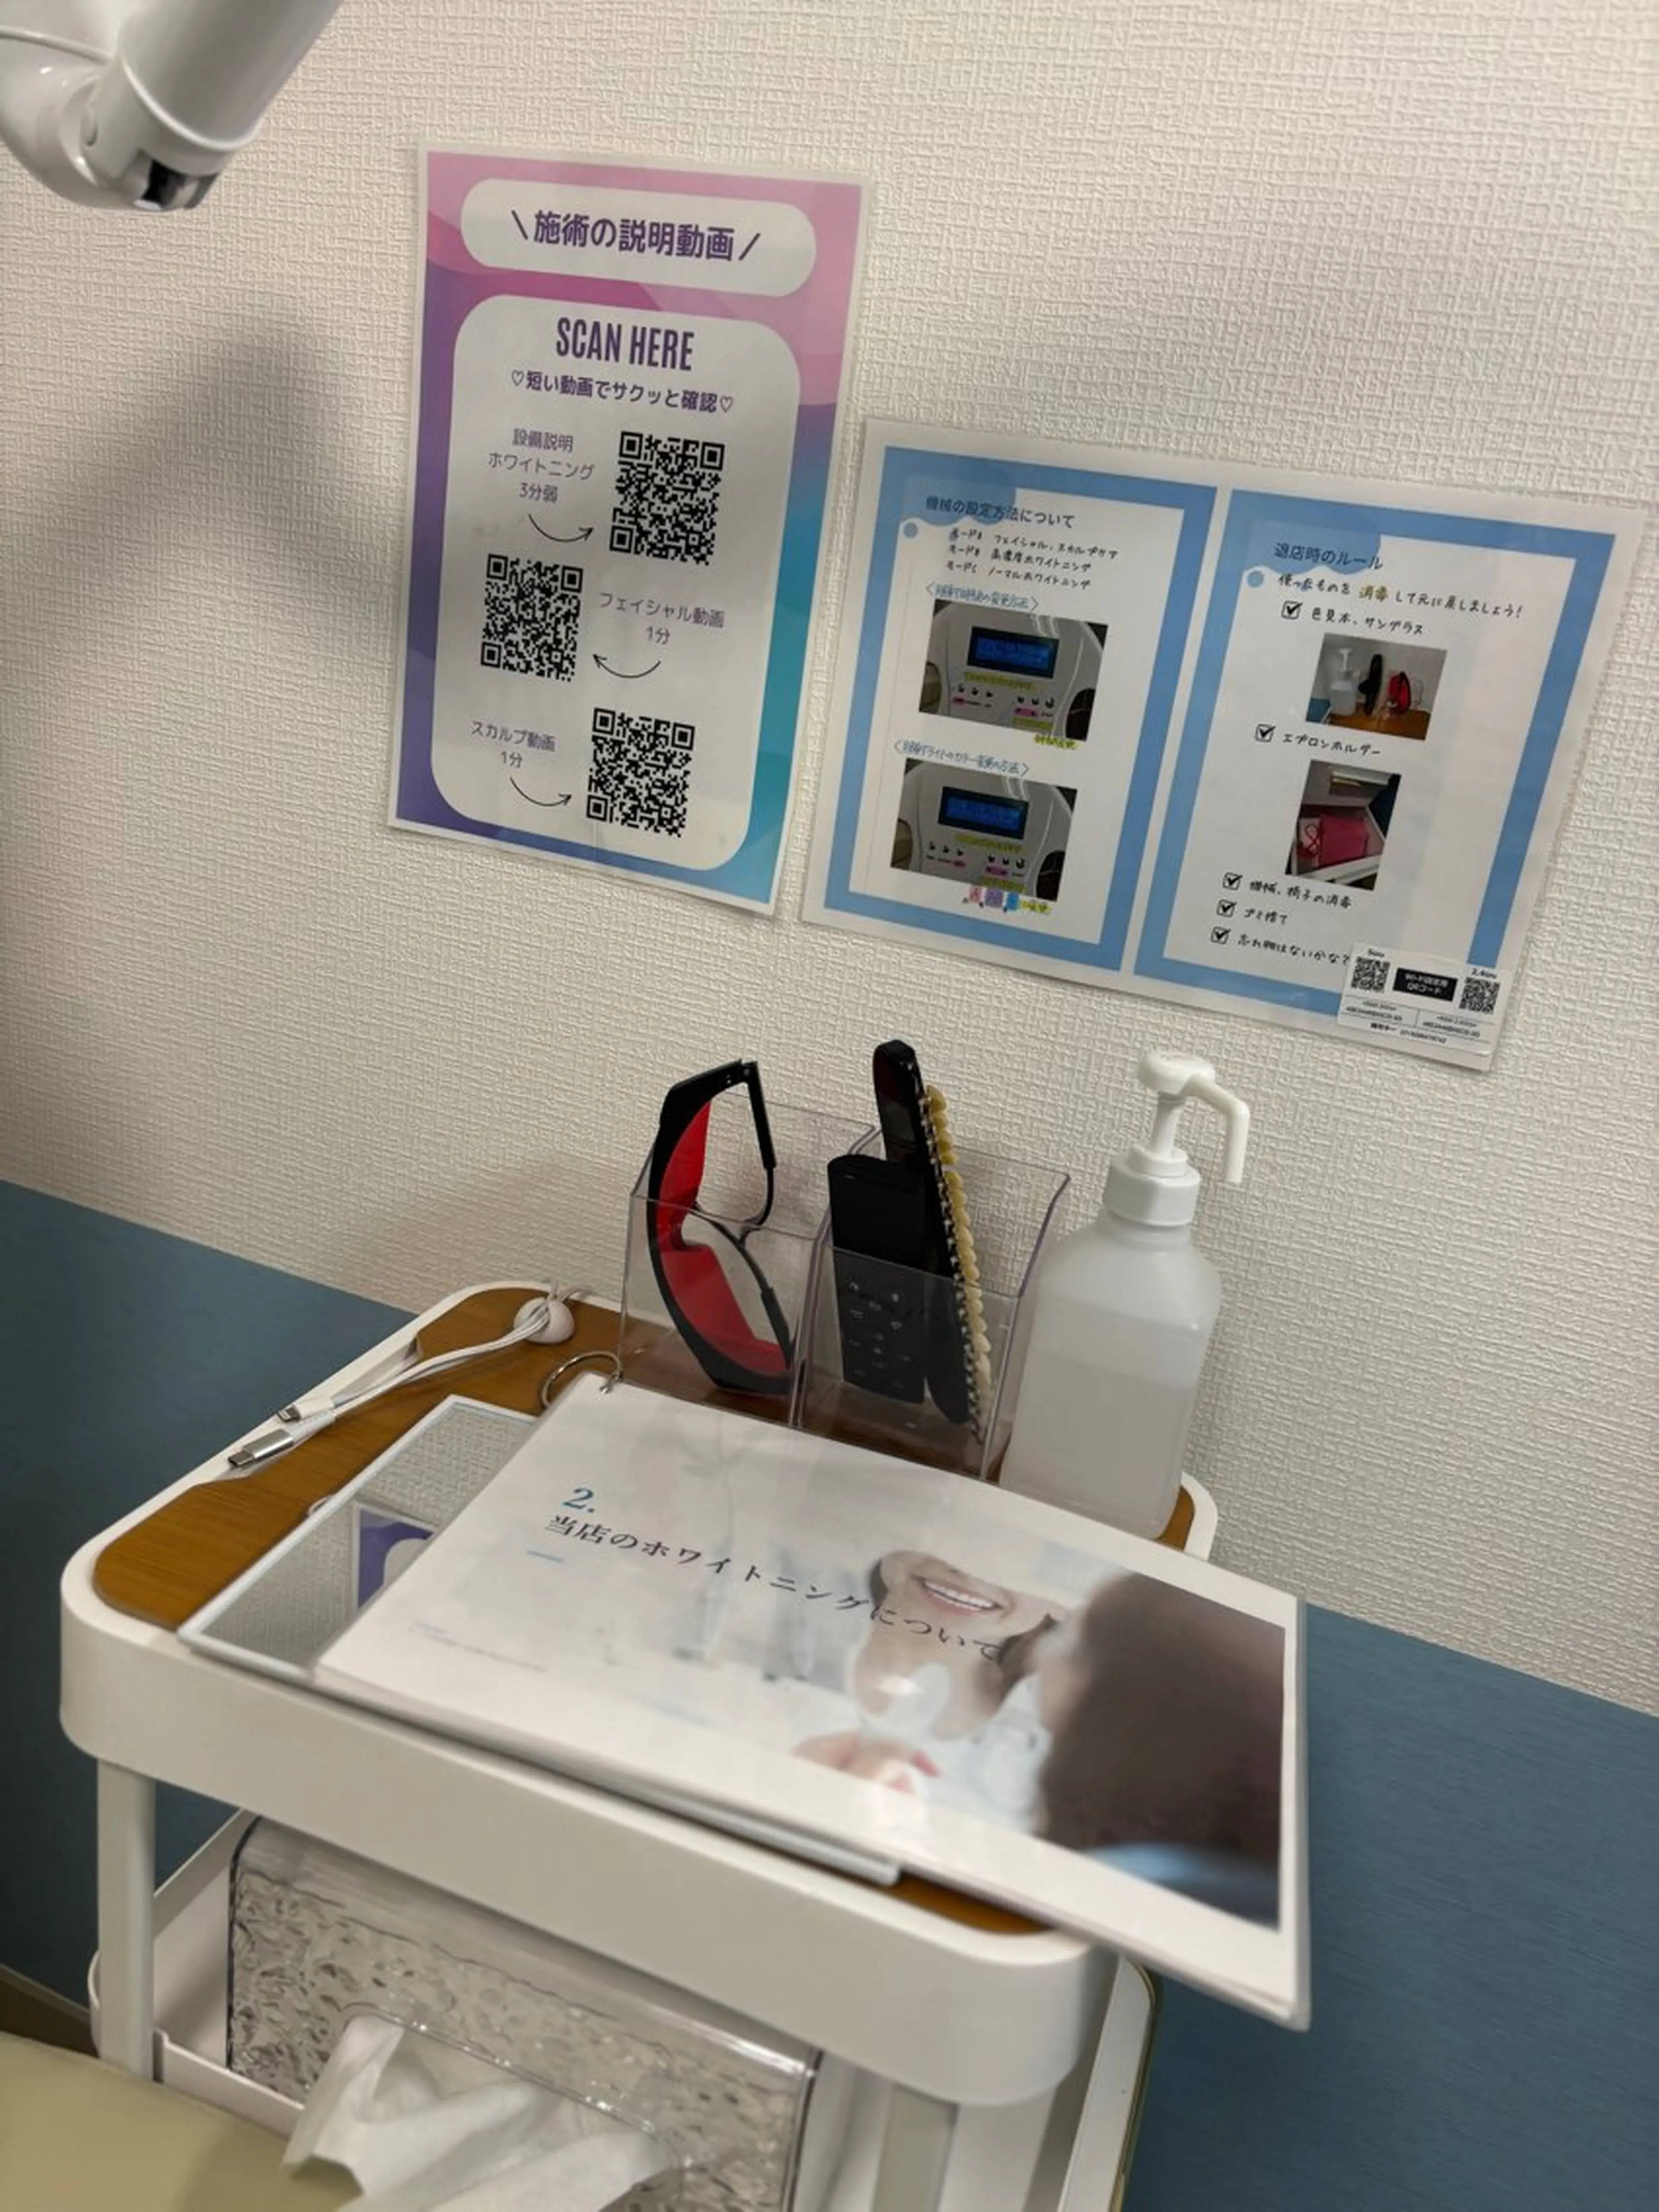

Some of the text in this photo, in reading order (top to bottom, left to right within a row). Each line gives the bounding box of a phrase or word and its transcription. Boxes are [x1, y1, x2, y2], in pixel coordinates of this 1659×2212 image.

[534, 210, 735, 261] 施術の説明動画
[556, 317, 694, 371] SCAN HERE
[513, 428, 574, 453] 設備説明
[488, 452, 594, 480] ホワイトニング
[519, 482, 558, 503] 3分弱
[926, 496, 1075, 528] 機械の設定方法について
[1274, 542, 1383, 570] 退店時のルール
[599, 593, 725, 629] フェイシャル動画
[647, 626, 671, 645] 1分
[471, 721, 556, 752] スカルプ動画
[1282, 733, 1381, 756] エプロンホルダー
[500, 750, 523, 769] 1分
[1243, 908, 1288, 925] ゴミ捨て
[561, 1486, 597, 1514] 2.
[544, 1513, 1004, 1662] 当店のホワイトニングについて
